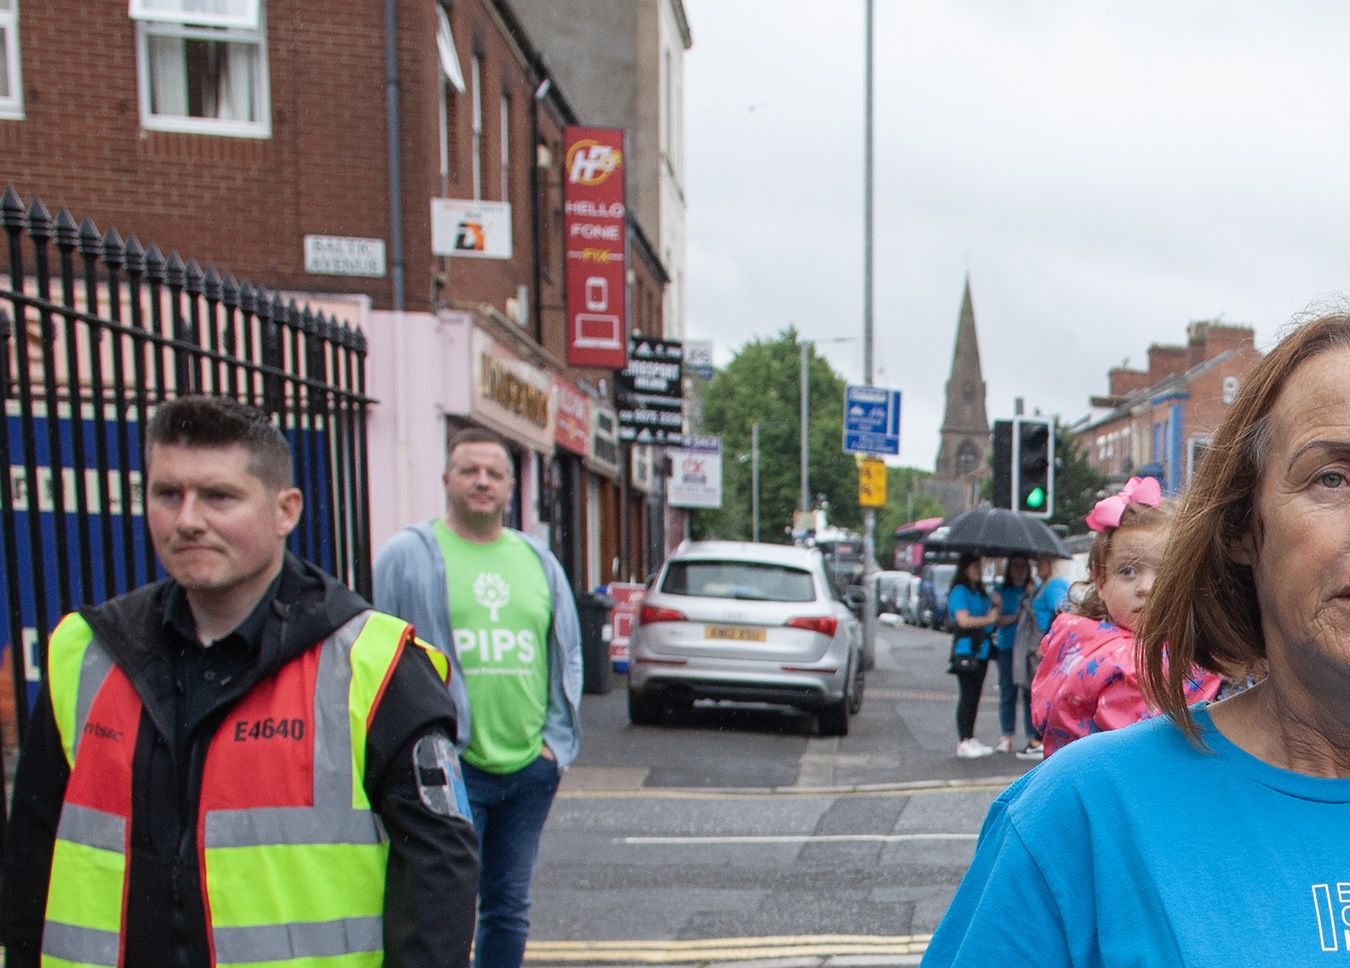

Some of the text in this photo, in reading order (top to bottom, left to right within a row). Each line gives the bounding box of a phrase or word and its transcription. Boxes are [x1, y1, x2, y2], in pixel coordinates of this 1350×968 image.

[564, 200, 626, 219] HELLO
[570, 223, 620, 240] FONE
[311, 240, 373, 254] BALTIC
[311, 256, 378, 271] AVENUE
[452, 628, 536, 664] PIPS
[234, 717, 304, 742] E4640
